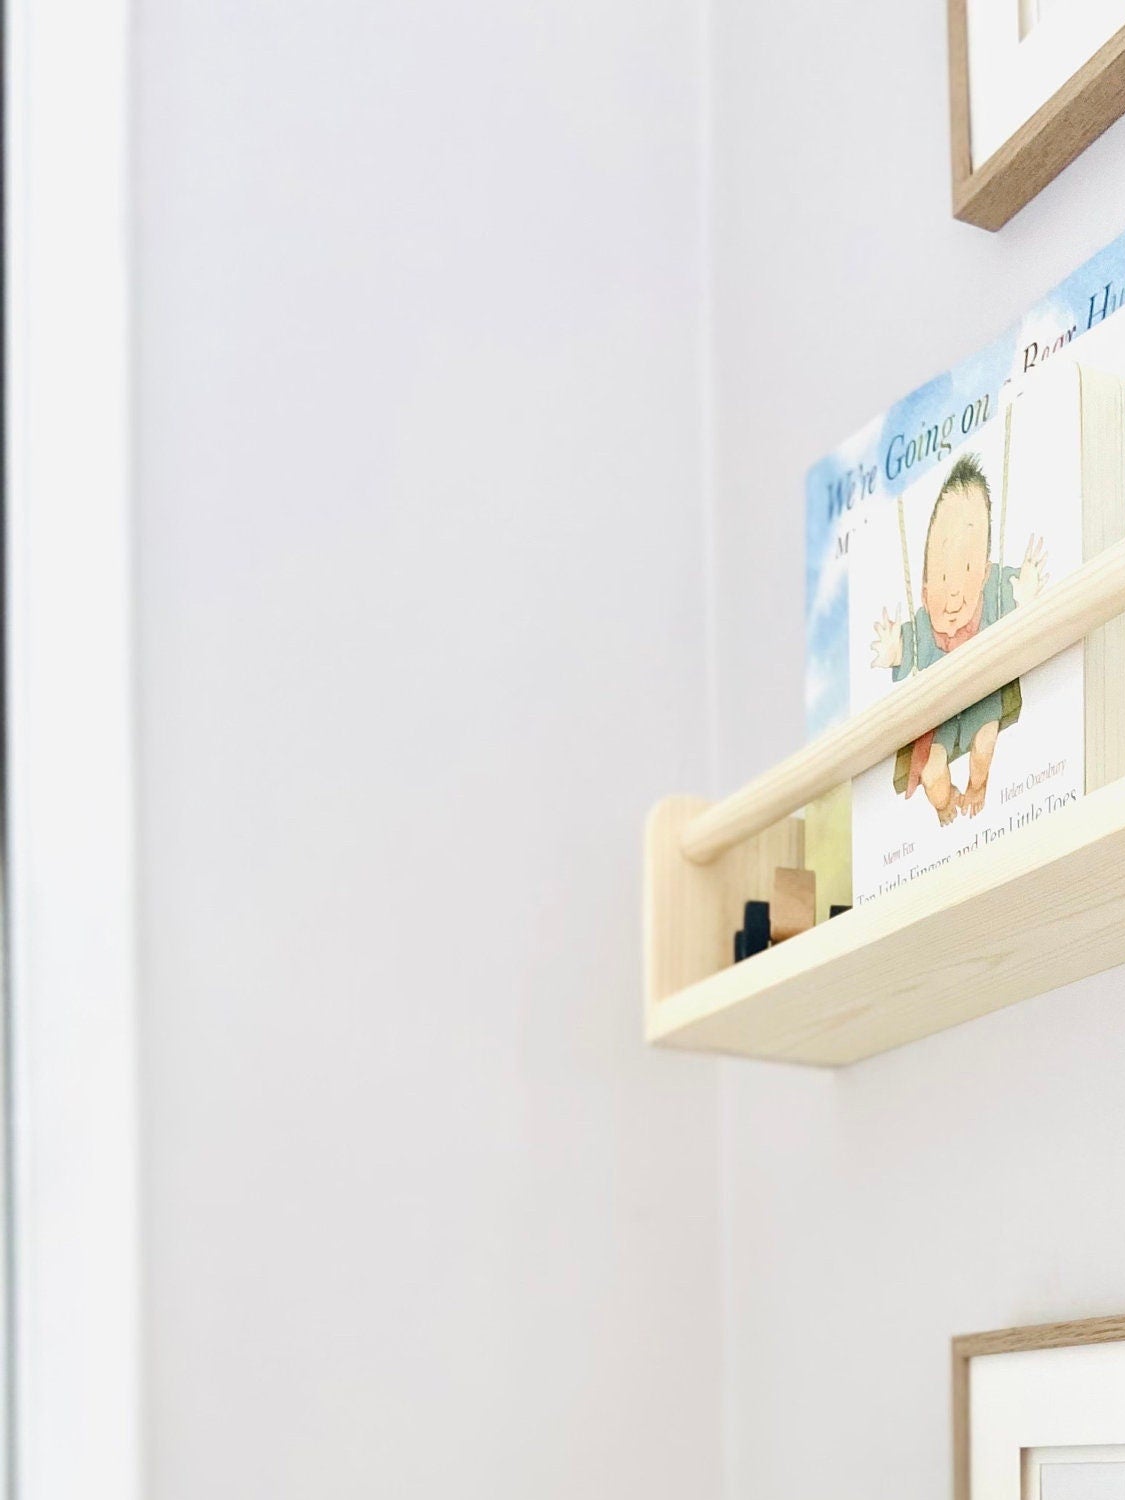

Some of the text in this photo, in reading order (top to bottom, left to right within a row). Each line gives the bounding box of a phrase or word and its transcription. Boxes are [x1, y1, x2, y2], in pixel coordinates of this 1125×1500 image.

[827, 464, 878, 523] We're
[885, 413, 955, 481] Going
[961, 394, 990, 434] on
